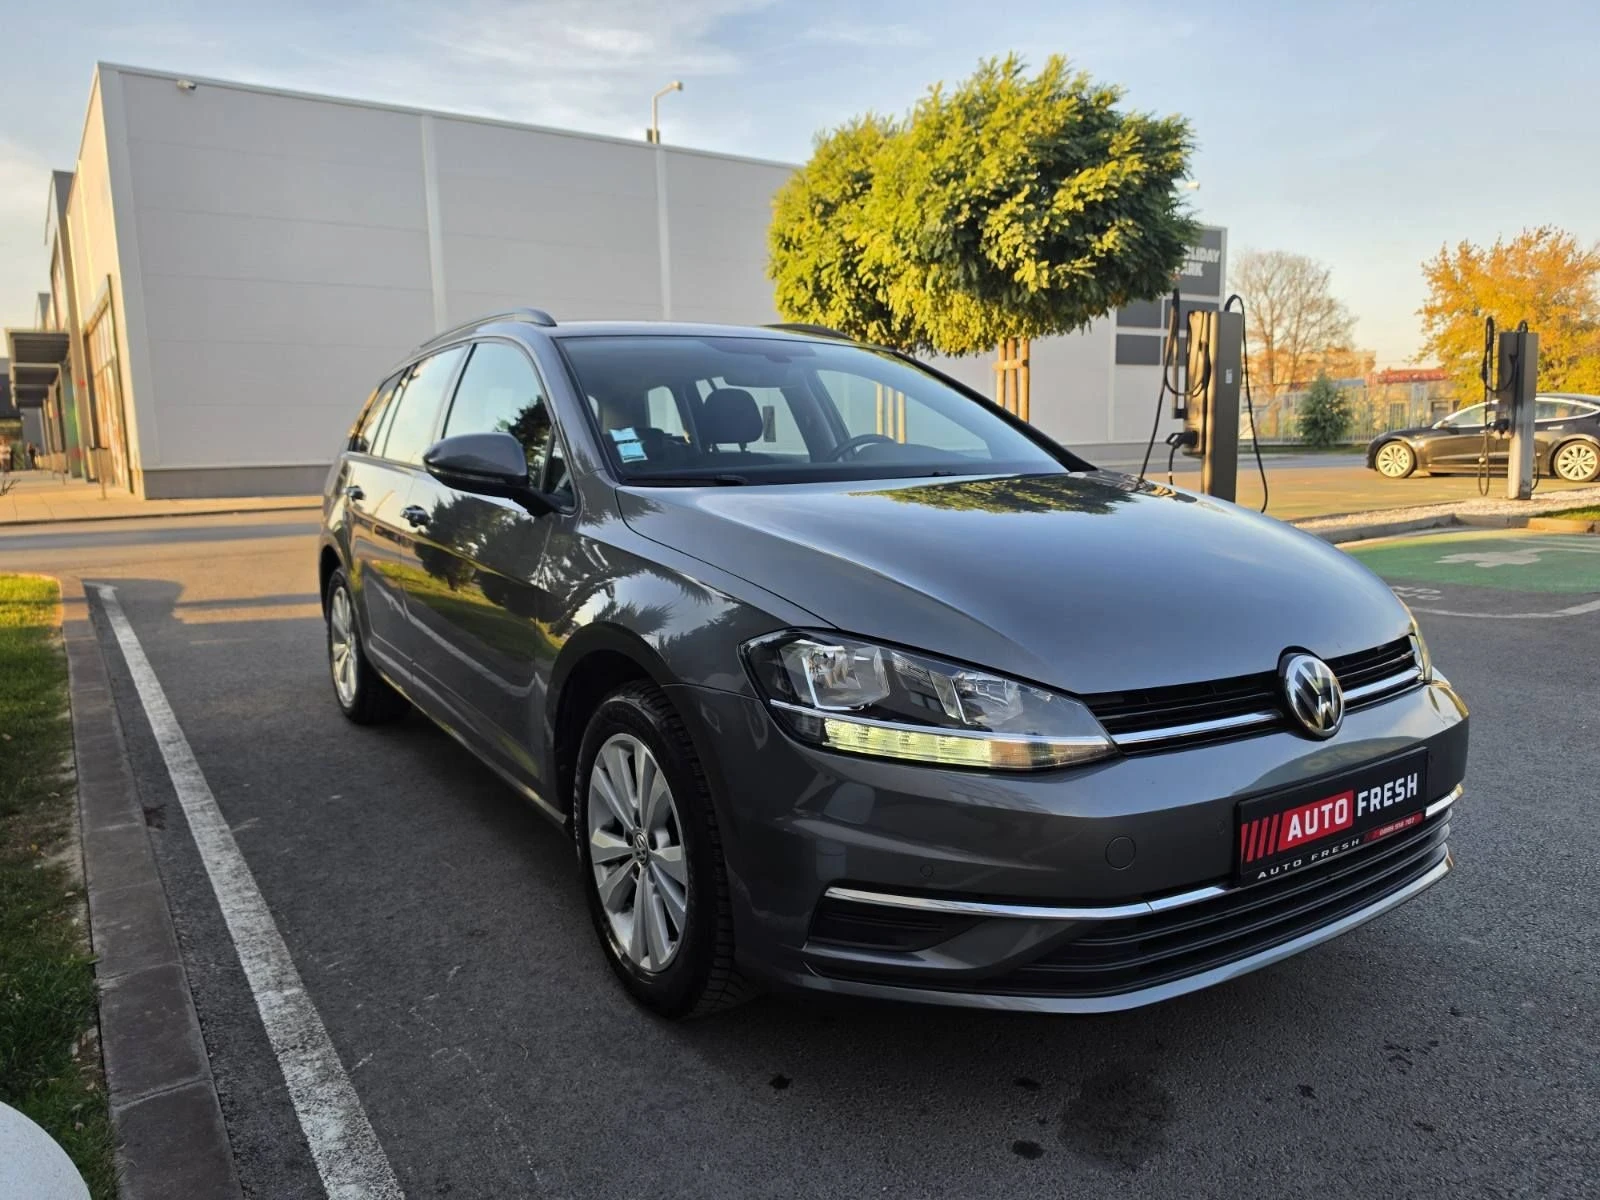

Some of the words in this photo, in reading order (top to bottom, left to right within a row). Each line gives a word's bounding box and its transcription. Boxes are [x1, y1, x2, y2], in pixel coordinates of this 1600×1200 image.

[1287, 798, 1349, 842] AUTO
[1357, 772, 1418, 817] FRESH
[1257, 859, 1302, 880] AUTO
[1311, 838, 1360, 861] FRESH
